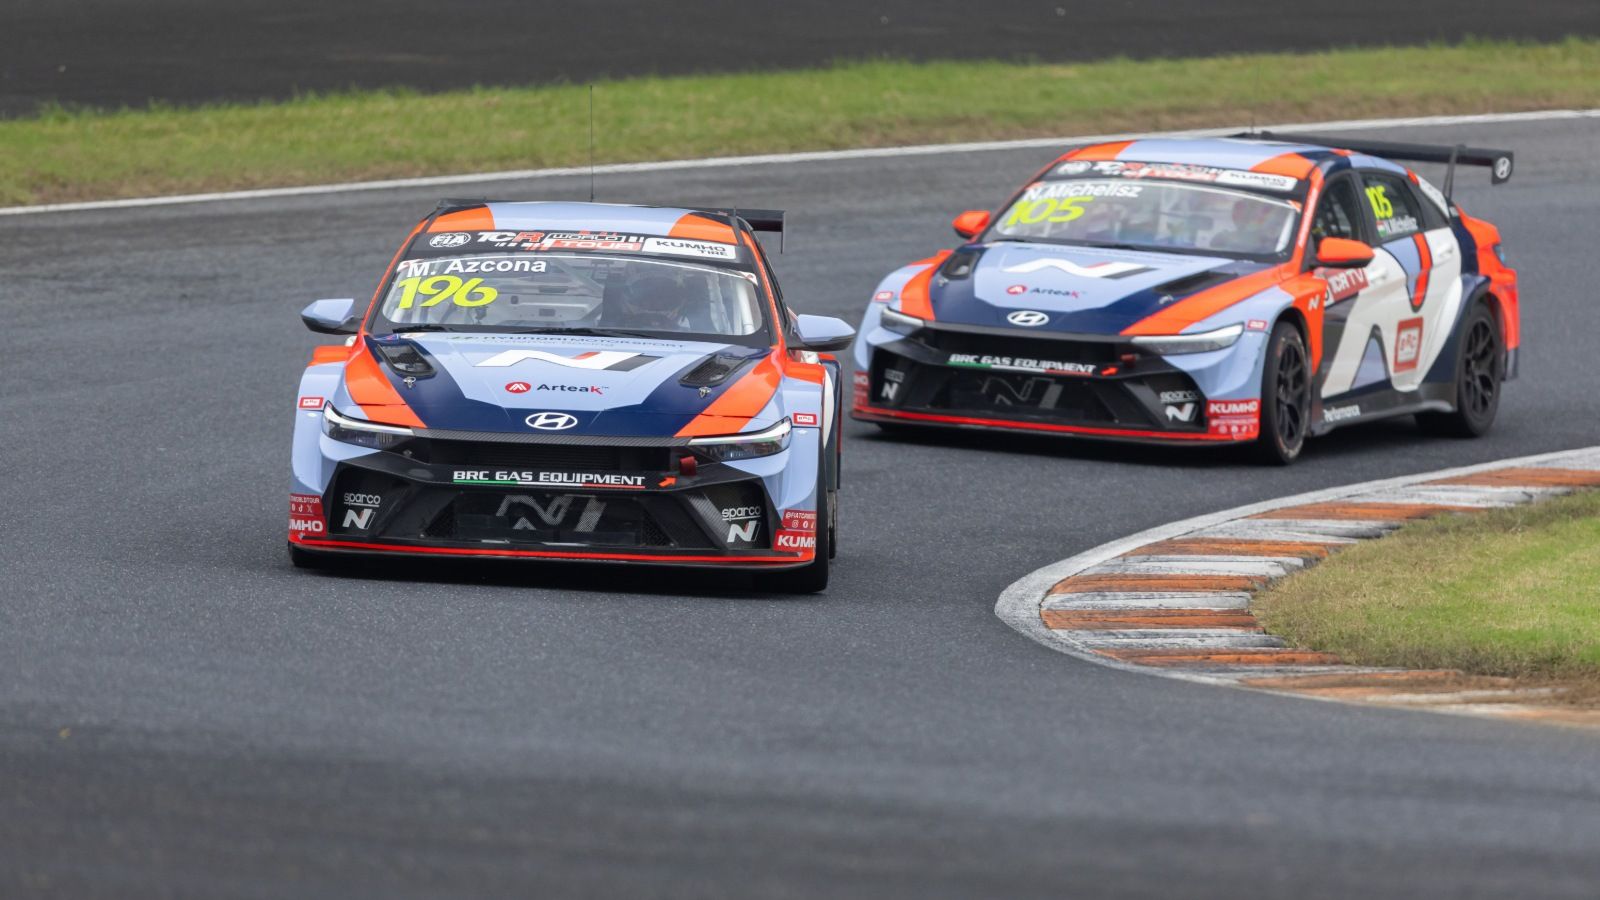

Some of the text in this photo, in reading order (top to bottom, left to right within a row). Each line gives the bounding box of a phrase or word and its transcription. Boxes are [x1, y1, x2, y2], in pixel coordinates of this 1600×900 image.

[1365, 185, 1393, 219] 105
[1005, 196, 1094, 228] 105
[430, 233, 468, 247] FIA
[477, 231, 545, 243] TCR
[561, 240, 635, 250] TOUR
[656, 240, 726, 252] KUMHO
[407, 259, 547, 277] M. Azcona
[398, 275, 498, 309] 196
[1030, 287, 1080, 298] Arteak
[949, 354, 1097, 373] BRC GAS EQUIPMENT
[537, 383, 603, 395] Arteak
[1209, 400, 1258, 414] KUMHO
[453, 470, 645, 486] BRC GAS EQUIPMENT
[343, 492, 381, 506] sparco
[722, 506, 761, 521] sparco
[289, 518, 323, 532] MHO
[777, 535, 816, 548] KUMH
